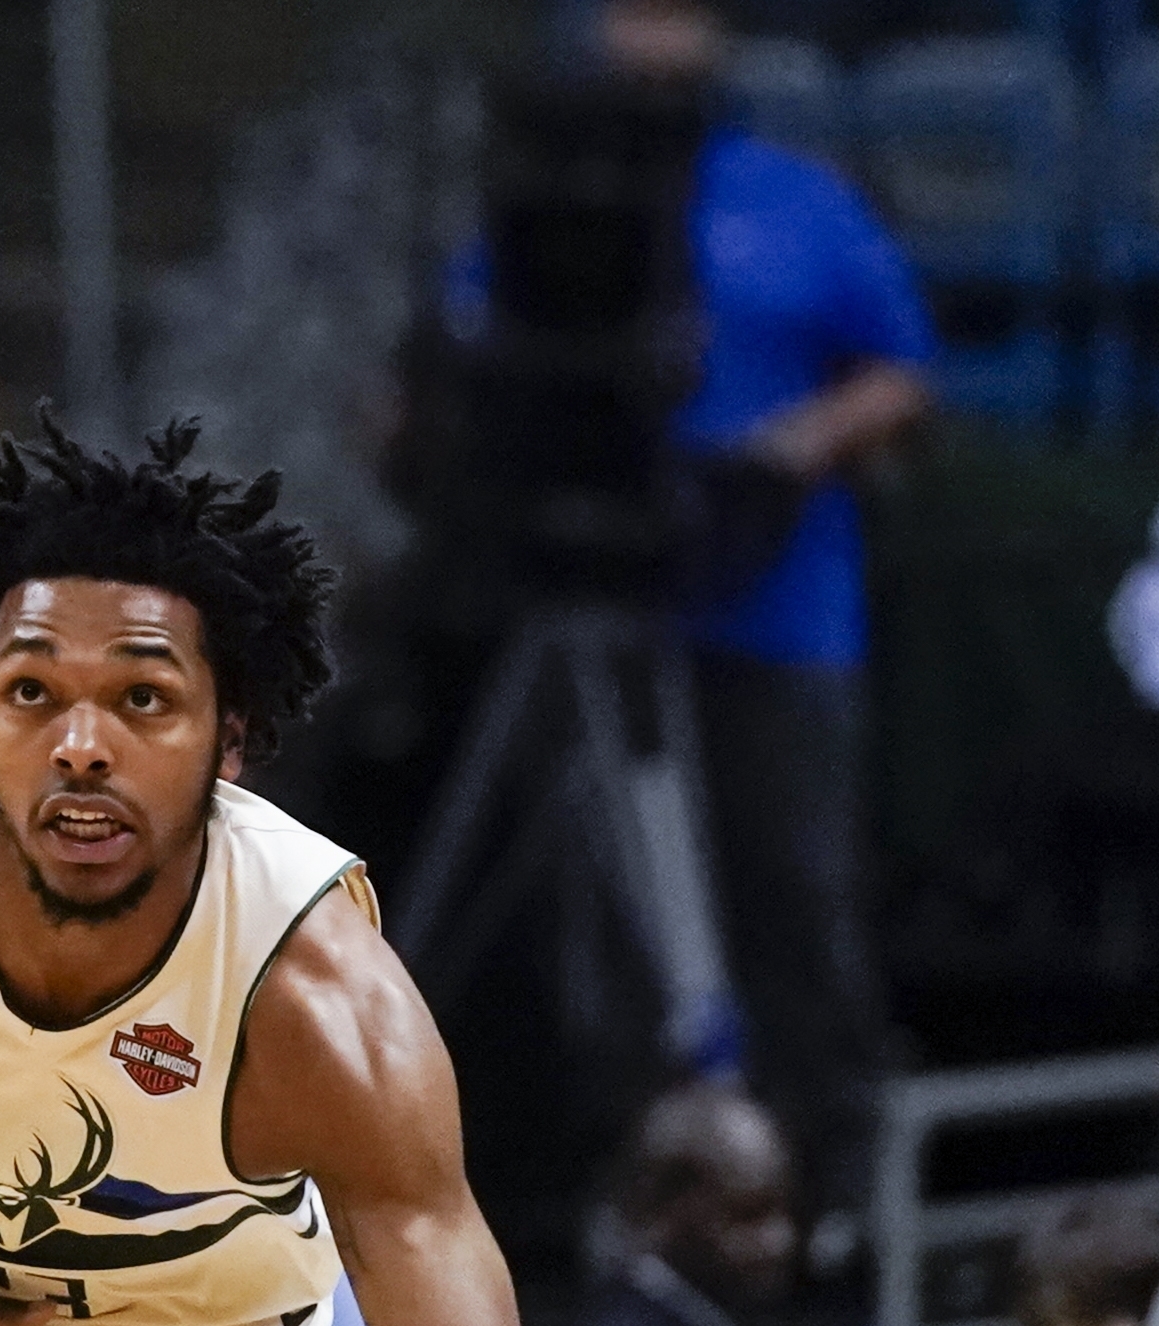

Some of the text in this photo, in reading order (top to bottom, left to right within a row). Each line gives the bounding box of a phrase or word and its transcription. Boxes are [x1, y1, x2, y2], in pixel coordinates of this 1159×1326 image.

[141, 1031, 186, 1052] MOTOR
[117, 1038, 197, 1080] HARLEY-DAVIDSON
[132, 1064, 176, 1089] CYCLES
